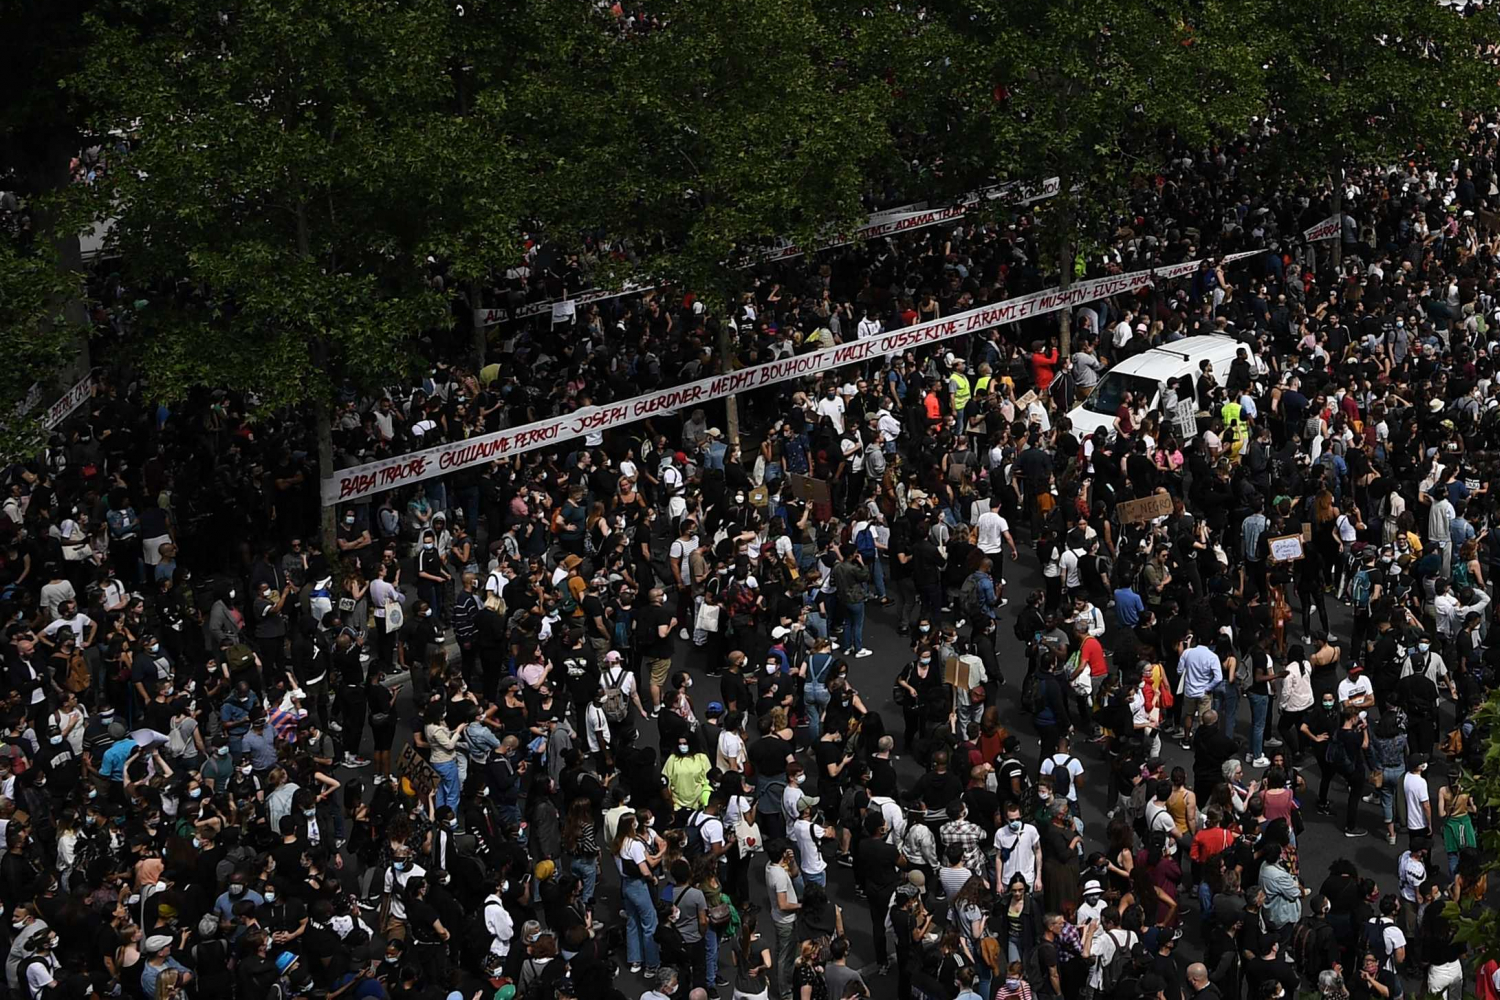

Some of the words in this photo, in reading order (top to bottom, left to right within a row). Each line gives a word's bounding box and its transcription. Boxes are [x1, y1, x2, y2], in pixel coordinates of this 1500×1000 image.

[339, 471, 377, 500] BABA
[439, 436, 512, 470] GUILLAUME
[571, 405, 628, 434] JOSEPH
[1019, 299, 1038, 317] ET
[1093, 279, 1127, 298] ELVIS
[403, 746, 440, 789] BLACK
